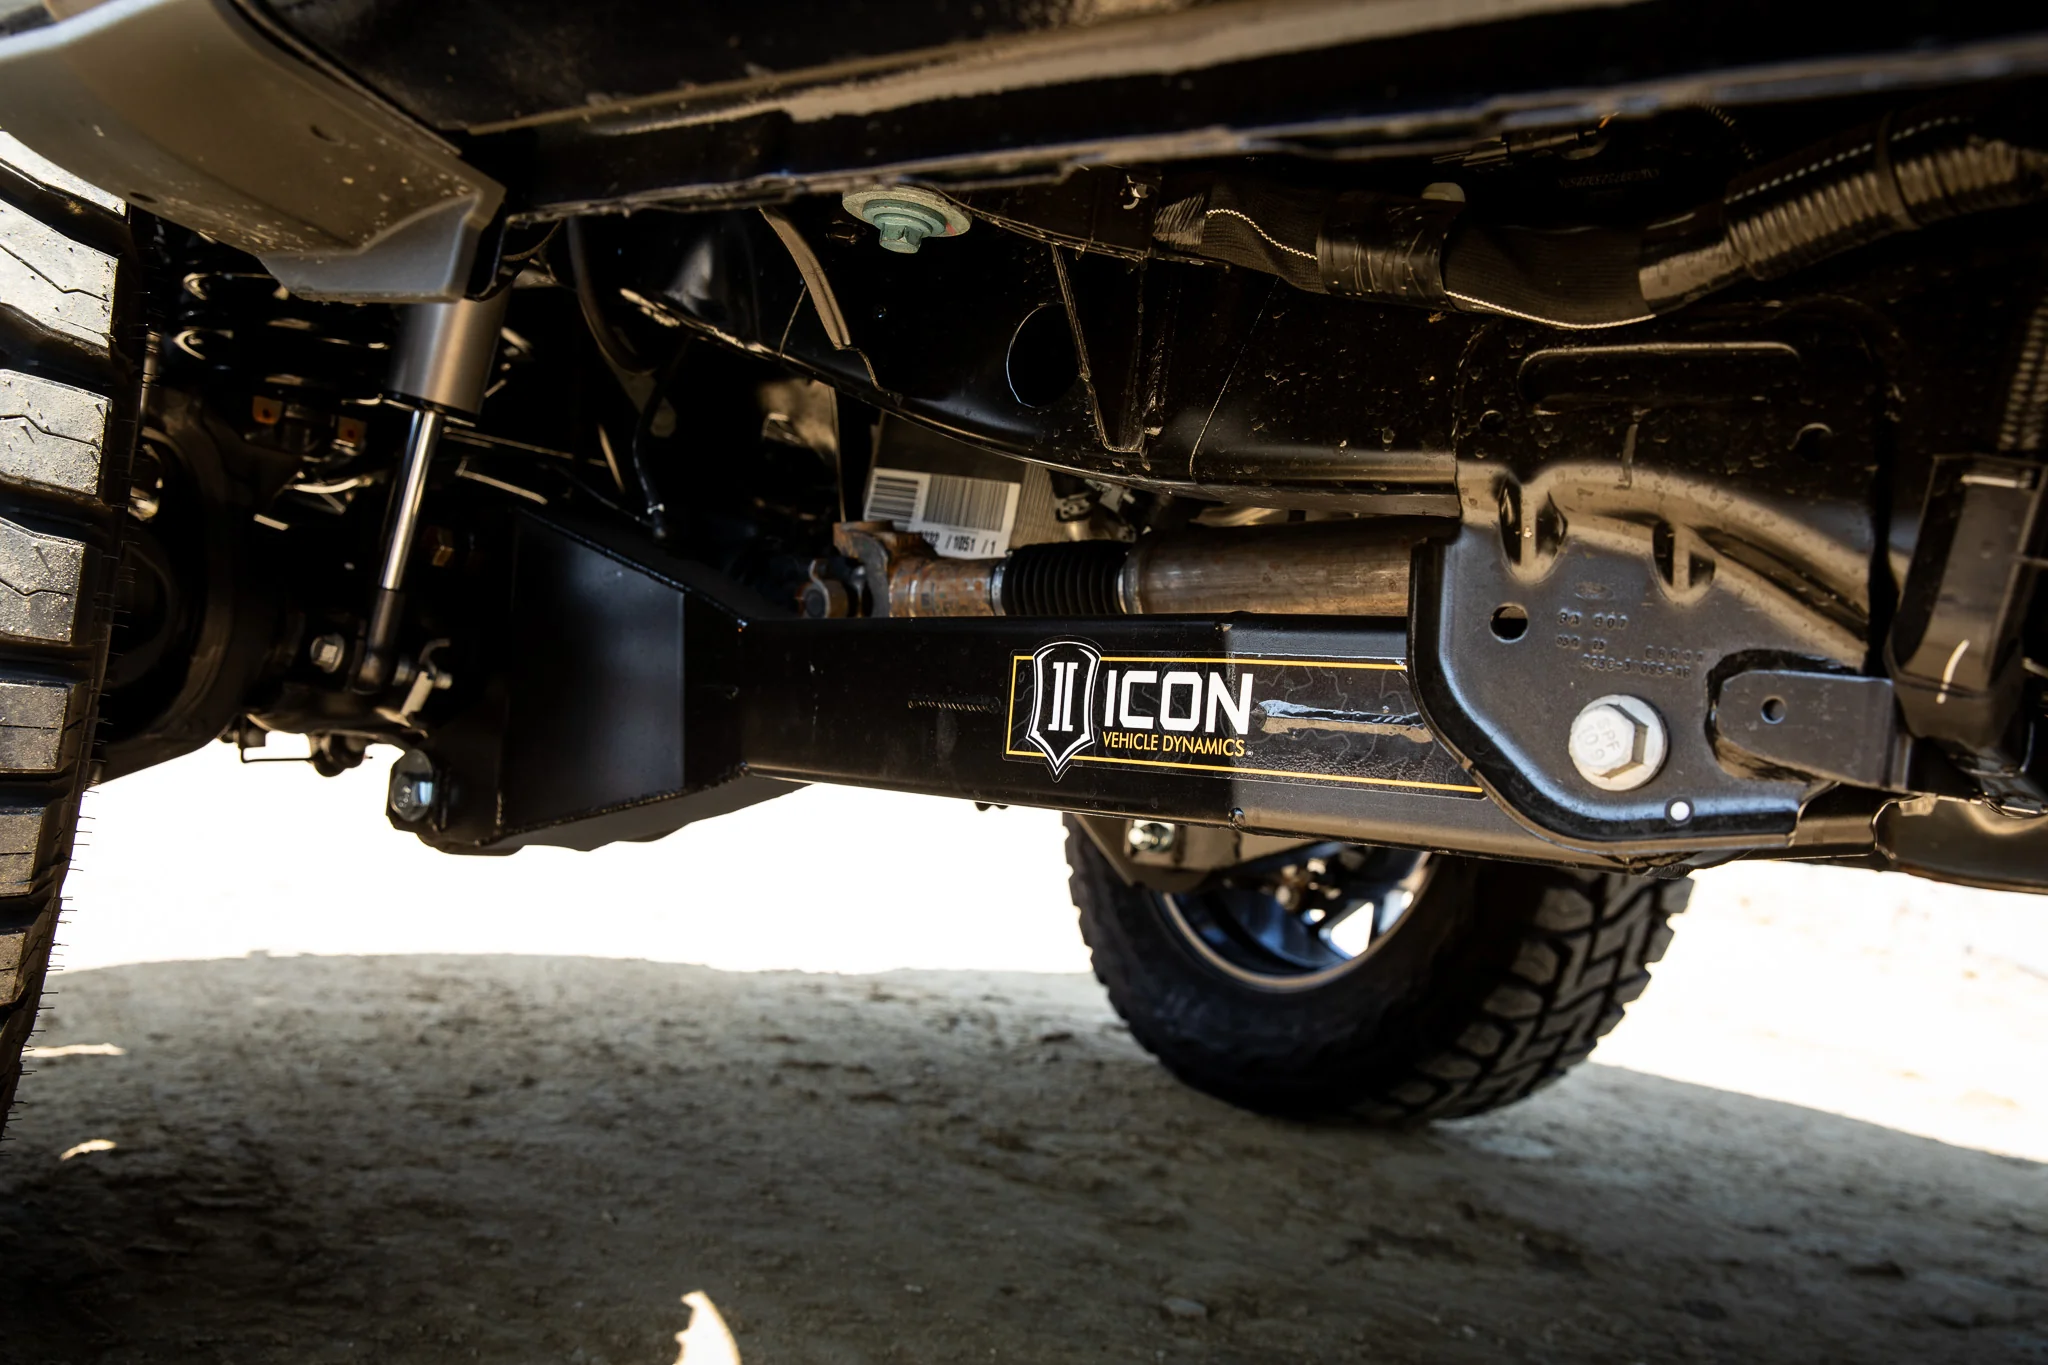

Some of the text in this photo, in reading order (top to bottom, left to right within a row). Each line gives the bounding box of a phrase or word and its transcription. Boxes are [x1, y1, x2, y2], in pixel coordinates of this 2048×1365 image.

[1104, 670, 1254, 735] ICON
[1103, 731, 1245, 757] VEHICLE DYNAMICS
